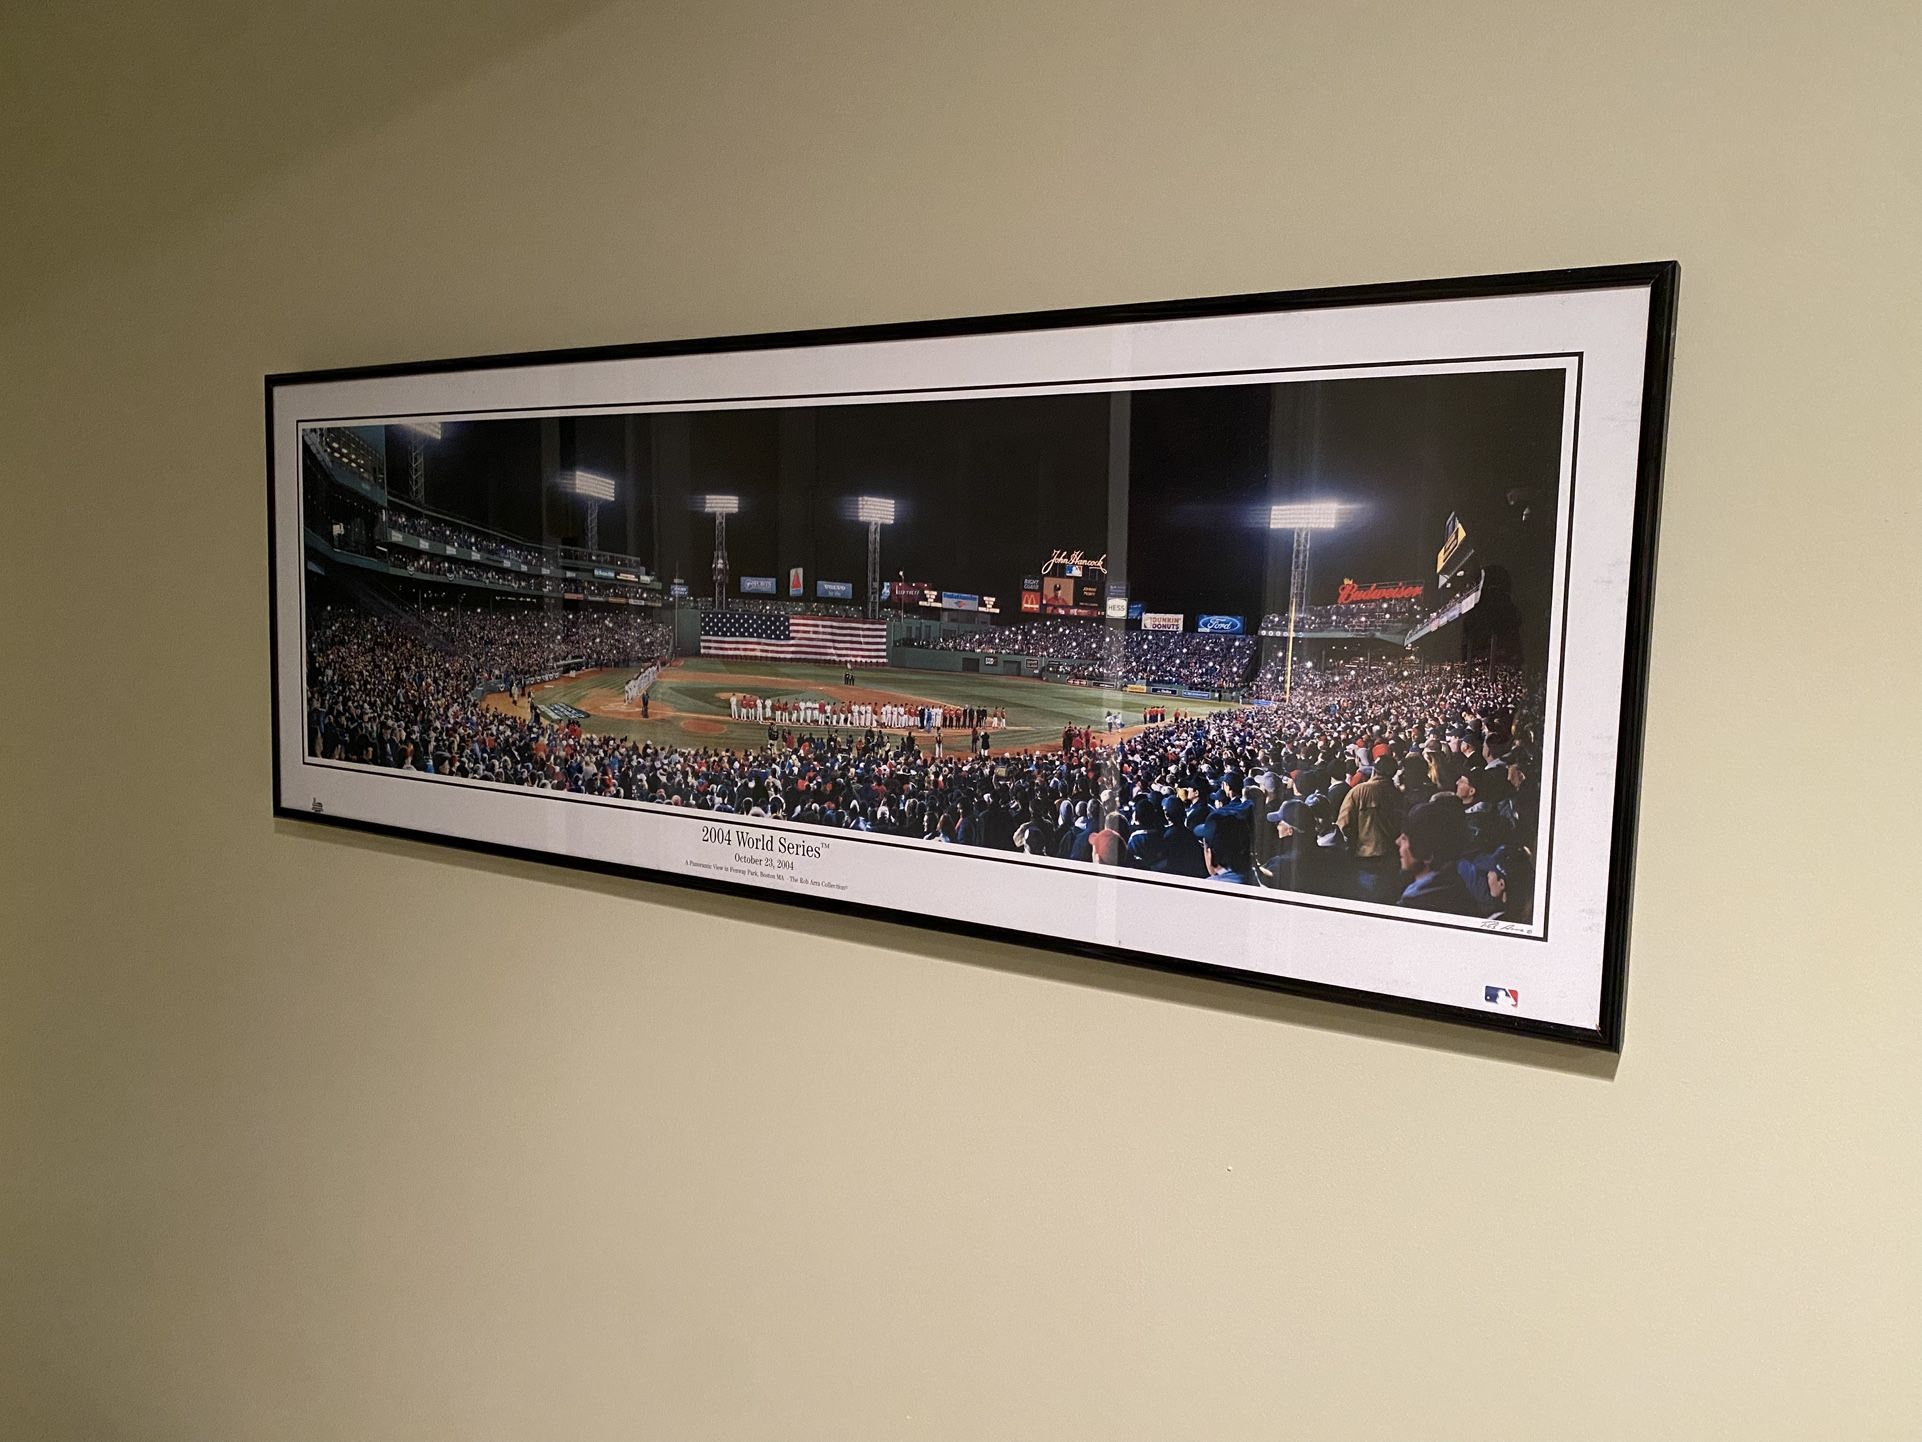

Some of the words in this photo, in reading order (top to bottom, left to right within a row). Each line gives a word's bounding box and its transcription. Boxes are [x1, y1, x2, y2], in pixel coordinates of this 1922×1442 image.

[1041, 549, 1068, 575] John
[1067, 550, 1108, 575] Hancock
[1337, 583, 1424, 604] Budweiser
[1108, 604, 1125, 612] HESS
[1207, 618, 1232, 630] Ford
[702, 825, 732, 846] 2004
[736, 830, 774, 852] World
[735, 853, 762, 866] October
[764, 857, 775, 869] 23,
[777, 860, 794, 871] 2004
[713, 863, 723, 871] View
[760, 871, 776, 879] Boston
[776, 873, 785, 881] MA
[789, 875, 799, 883] The
[799, 877, 809, 885] Rob
